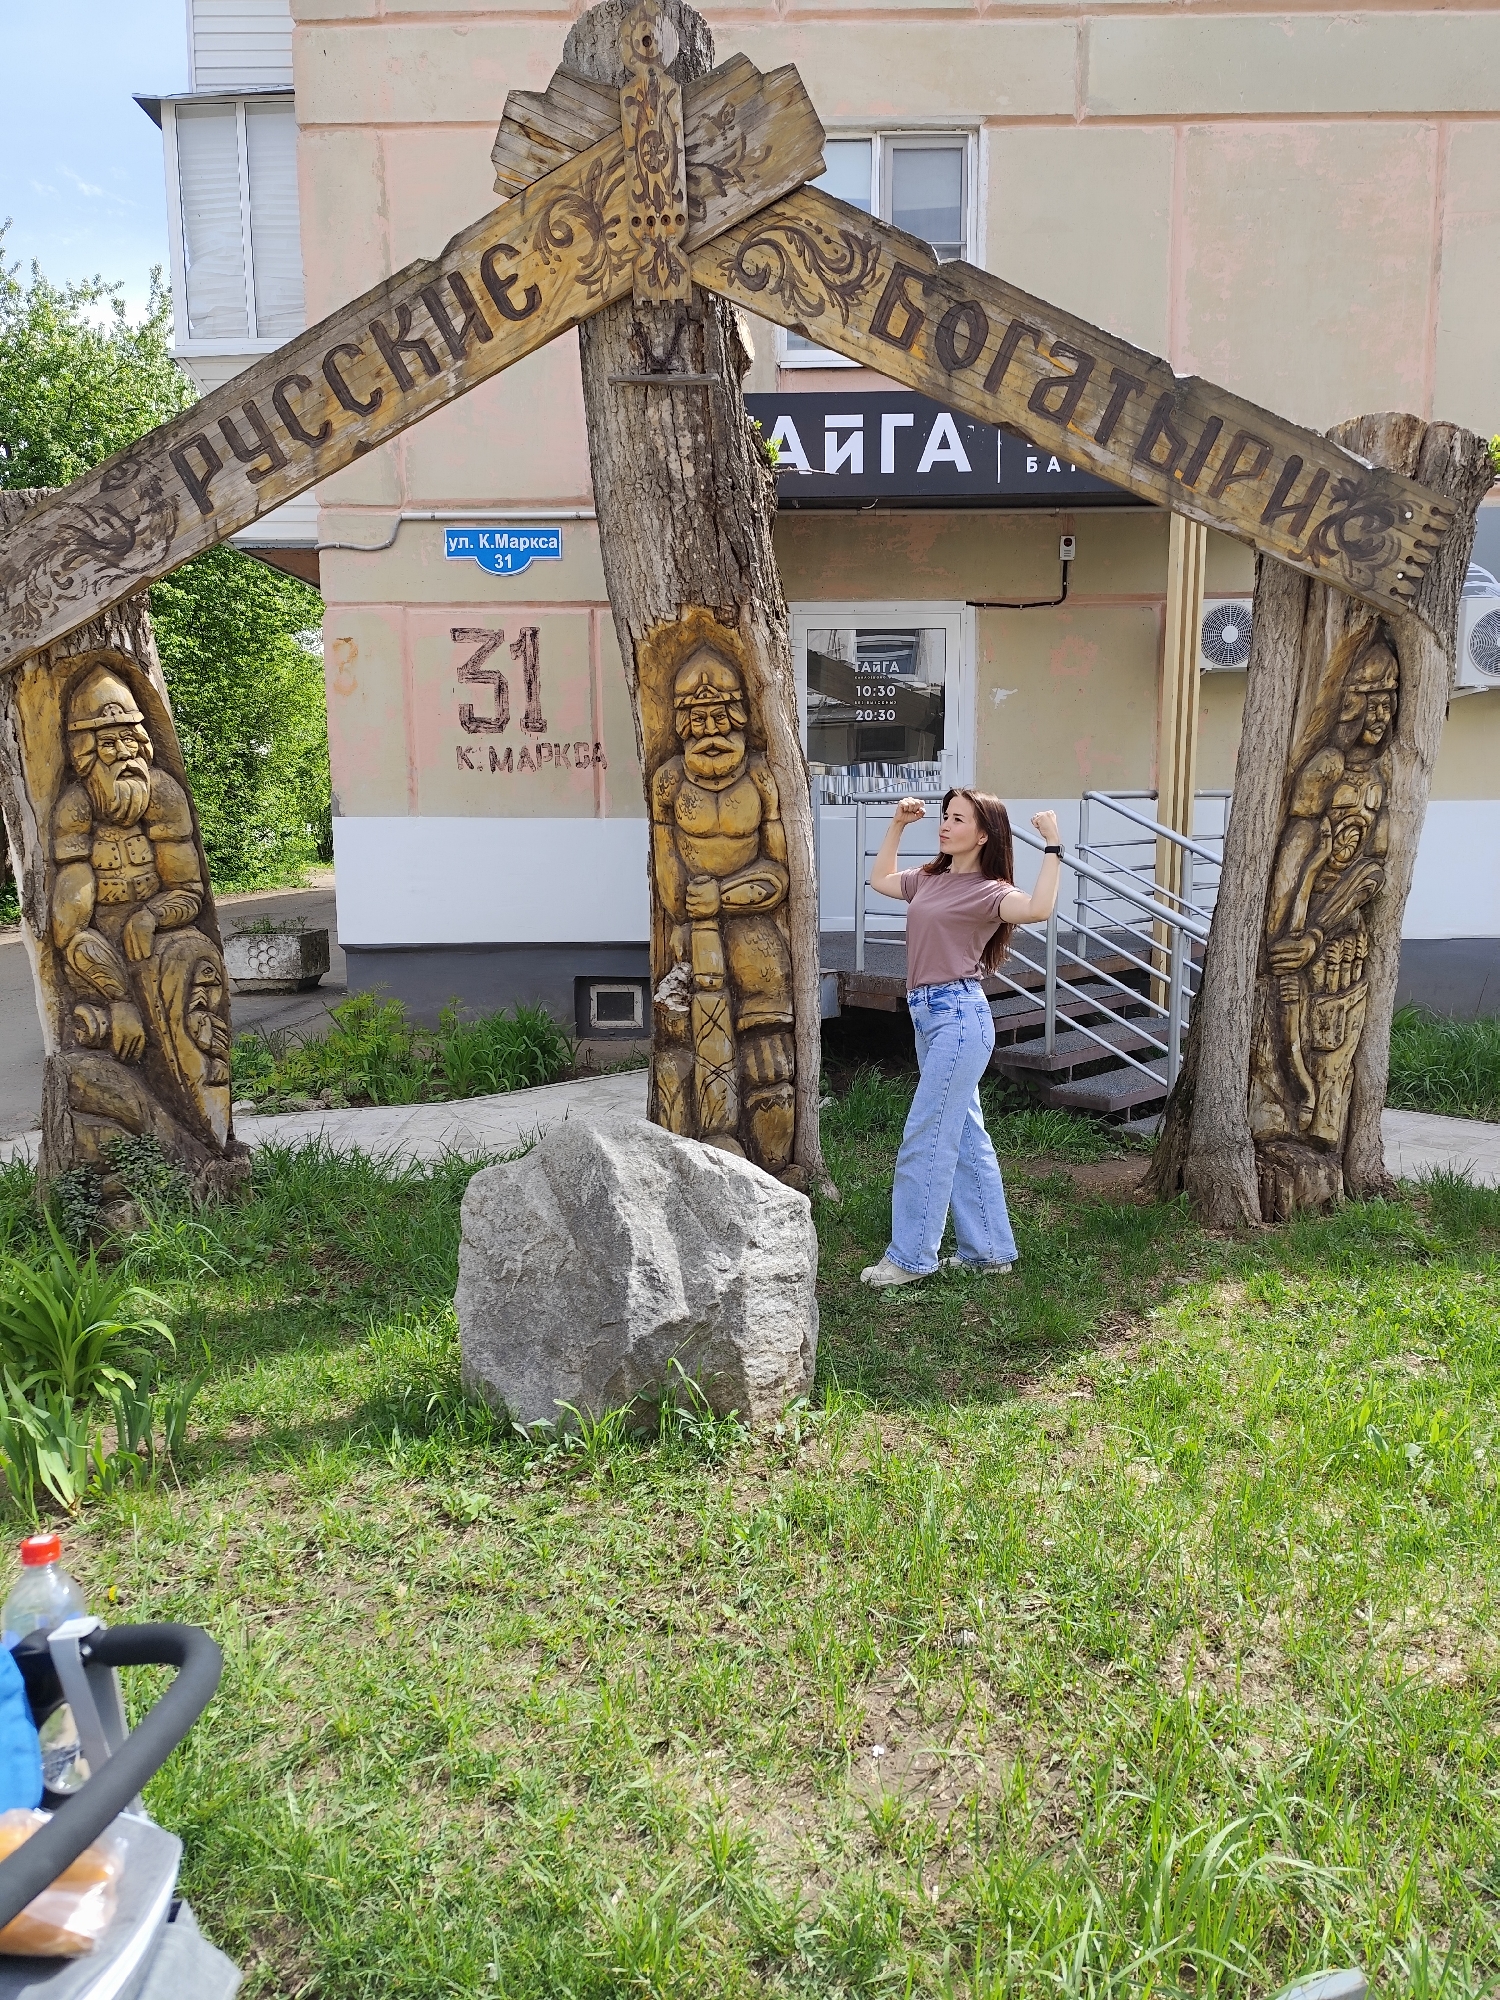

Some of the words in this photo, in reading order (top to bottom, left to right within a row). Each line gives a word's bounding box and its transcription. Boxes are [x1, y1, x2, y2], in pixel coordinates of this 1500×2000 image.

[169, 242, 542, 514] РУССКИЕ
[746, 412, 973, 474] АЙГА
[448, 537, 474, 552] ул.
[478, 533, 558, 552] К.Маркса
[494, 553, 512, 569] 31
[450, 626, 548, 734] 31
[855, 685, 896, 697] 10:30
[855, 709, 896, 721] 20:30
